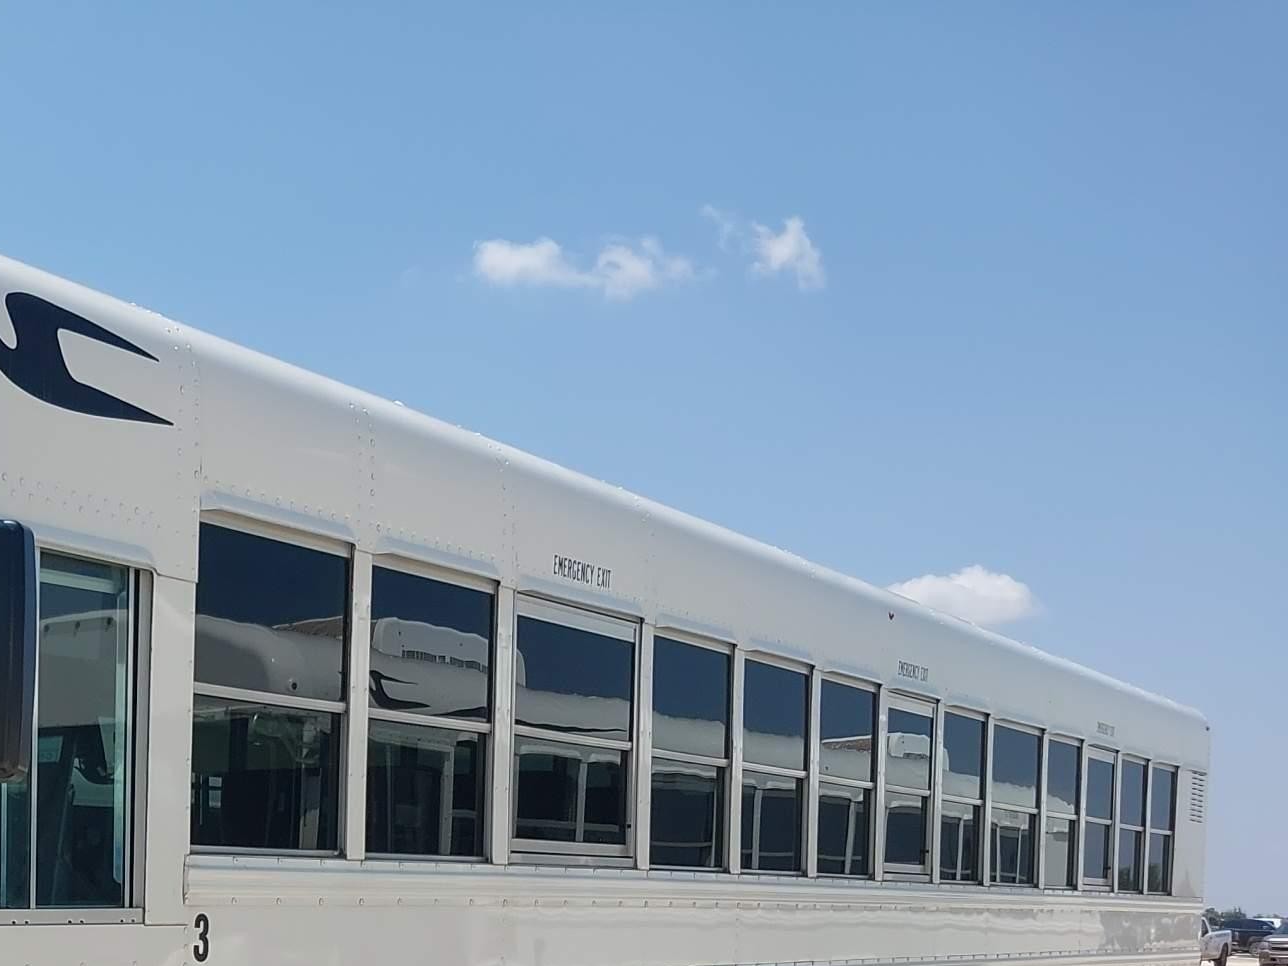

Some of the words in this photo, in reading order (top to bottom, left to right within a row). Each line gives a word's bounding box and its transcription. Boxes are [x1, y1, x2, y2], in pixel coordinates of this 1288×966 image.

[553, 554, 595, 585] EMERGENCY
[597, 567, 612, 589] EXIT
[193, 913, 210, 962] 3
